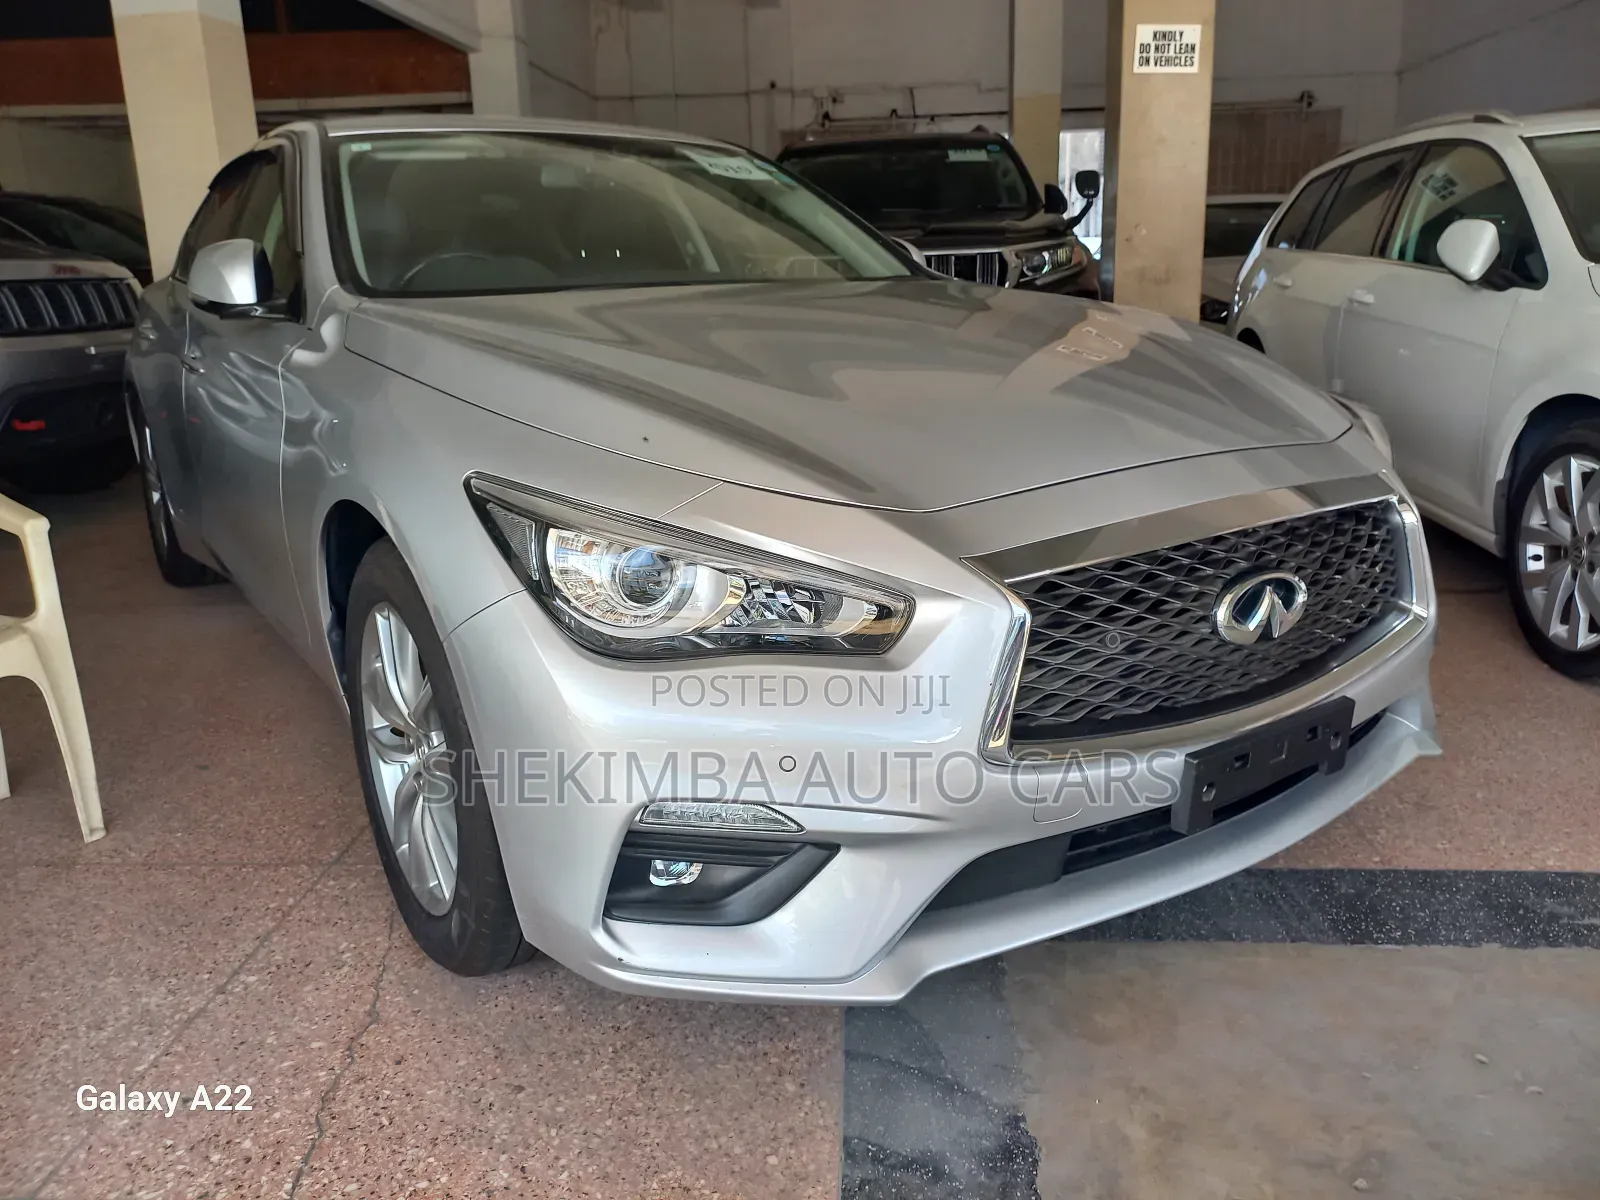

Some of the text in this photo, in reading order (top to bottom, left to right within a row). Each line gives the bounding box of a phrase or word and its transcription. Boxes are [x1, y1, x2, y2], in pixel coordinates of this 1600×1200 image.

[1152, 30, 1184, 42] KINDLY
[1139, 43, 1196, 54] DO NOT LEAN
[1138, 55, 1194, 67] ON VEHICLES
